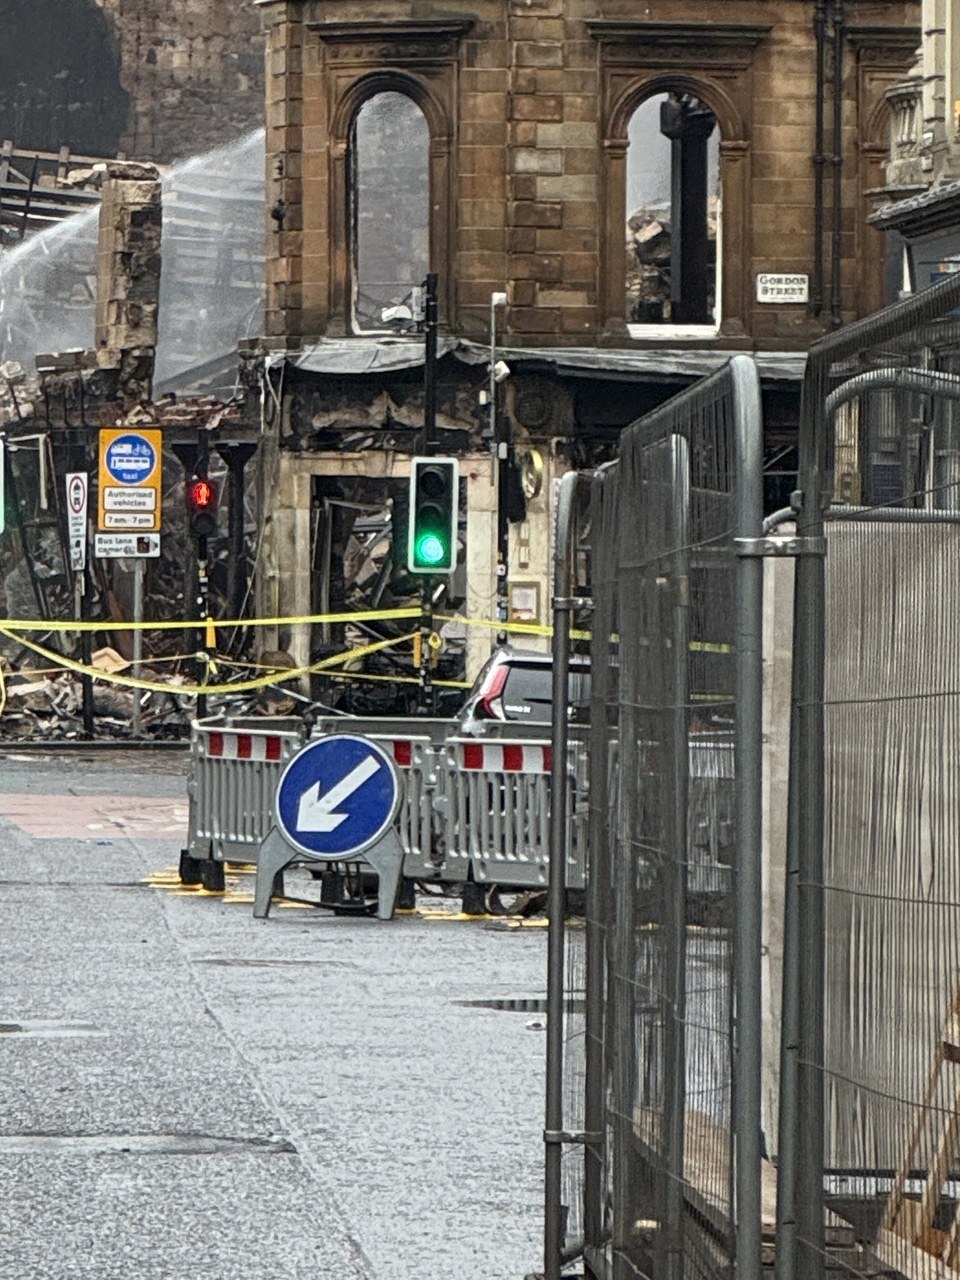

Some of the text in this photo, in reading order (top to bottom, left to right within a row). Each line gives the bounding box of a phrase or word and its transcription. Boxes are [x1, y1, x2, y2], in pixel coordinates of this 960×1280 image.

[760, 276, 806, 284] GORDON
[761, 286, 804, 295] STREET
[122, 472, 138, 480] taxi
[108, 490, 153, 498] Authorised
[113, 499, 146, 507] vehicles
[98, 537, 133, 545] Bus lane
